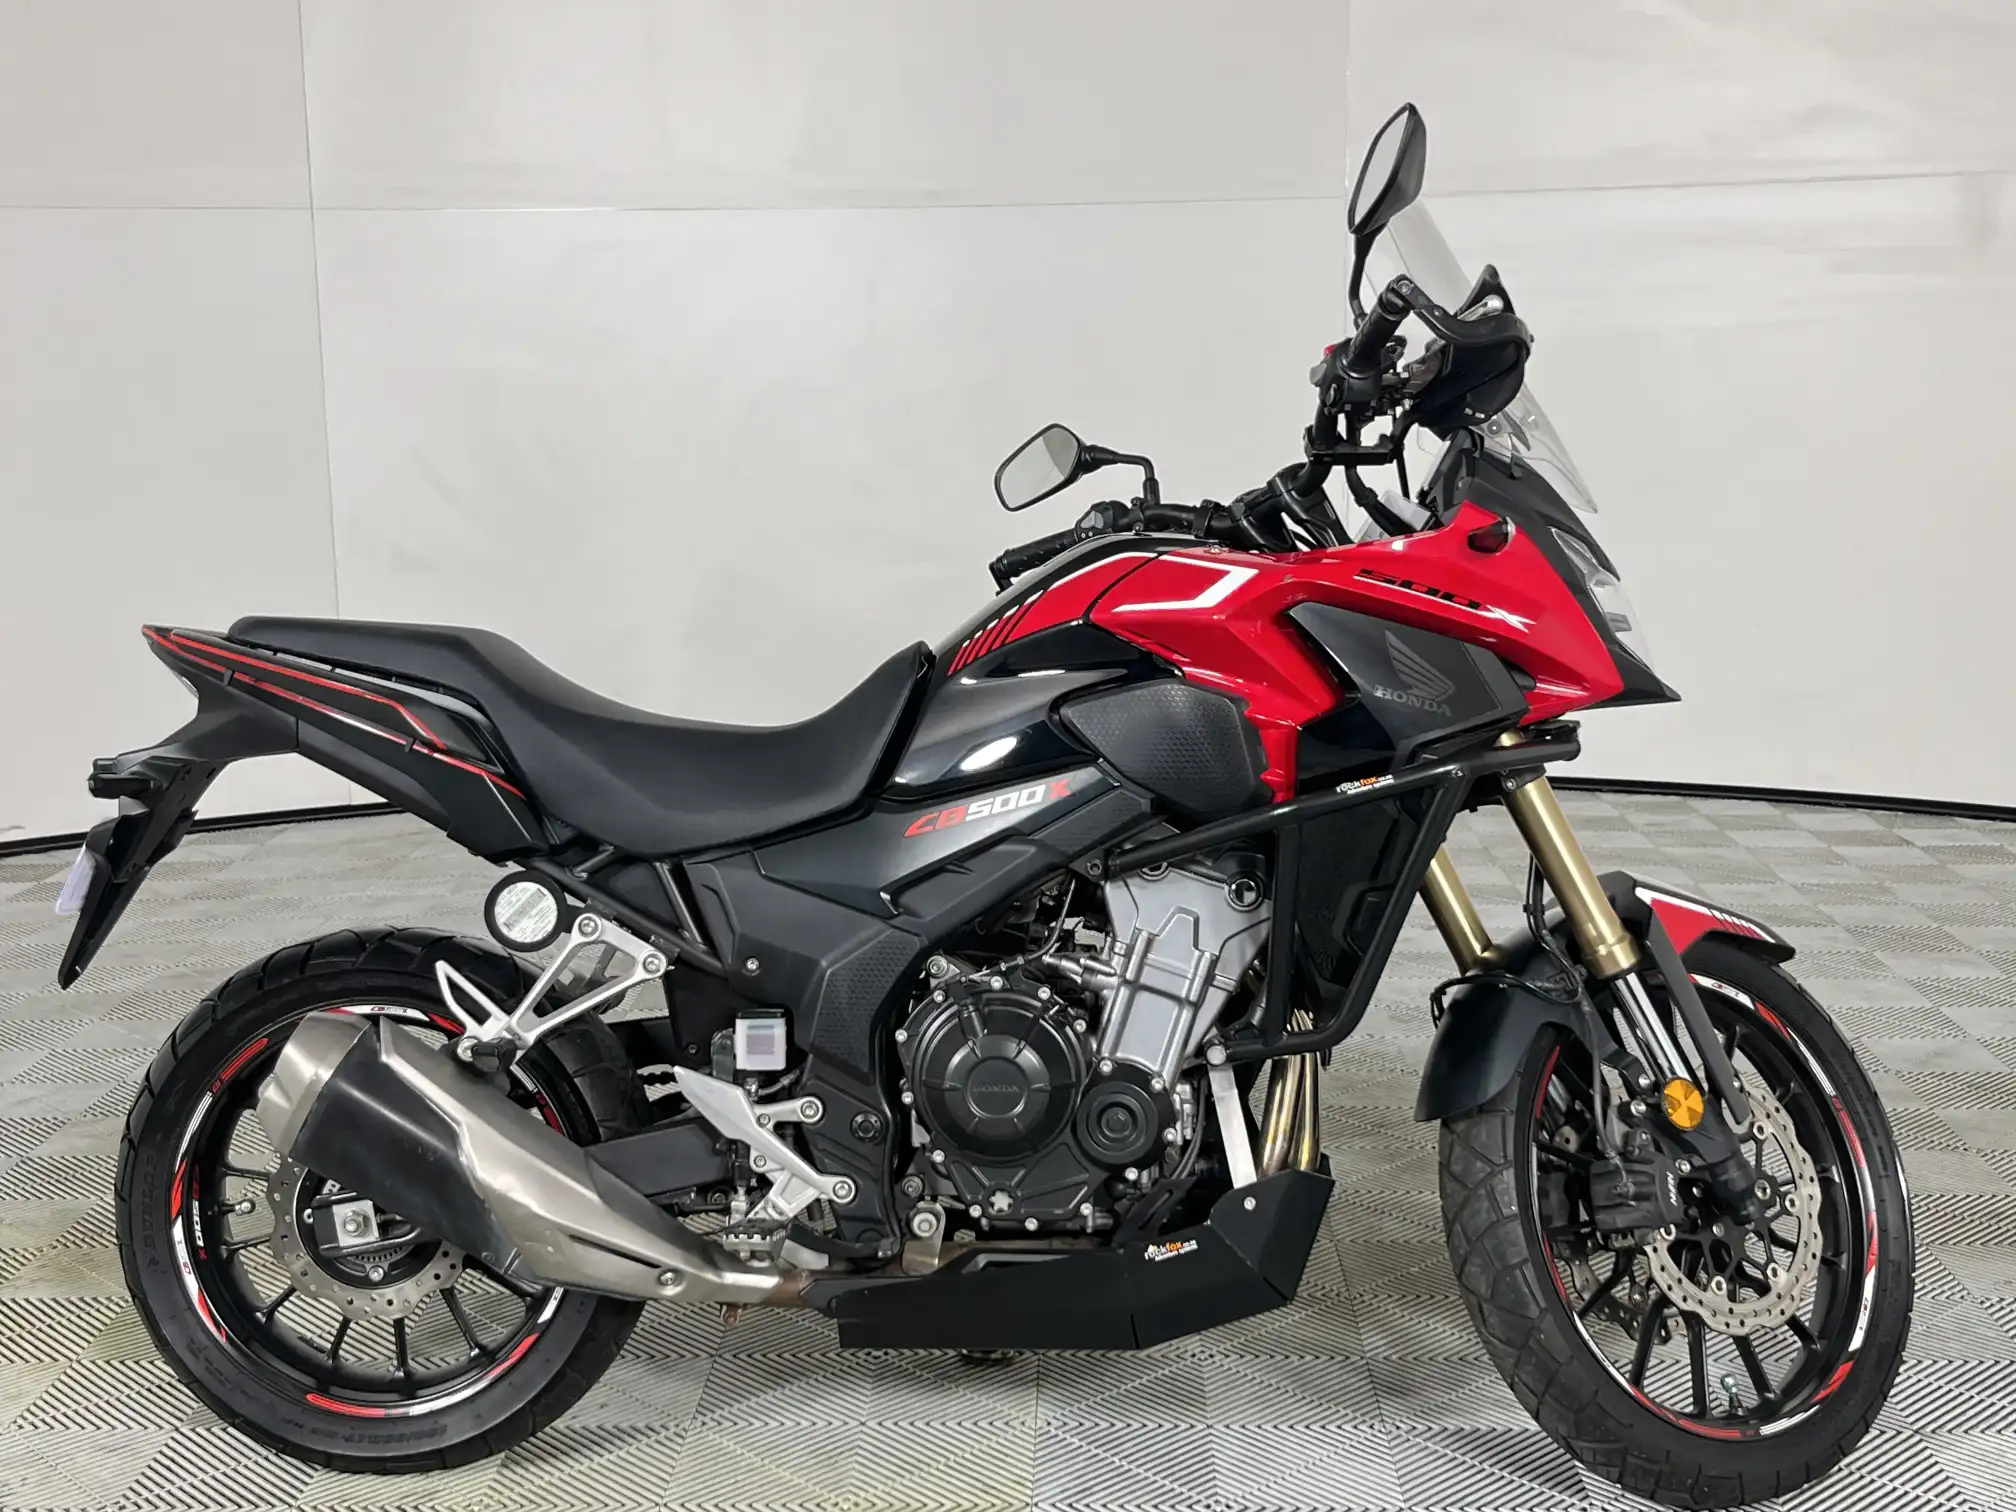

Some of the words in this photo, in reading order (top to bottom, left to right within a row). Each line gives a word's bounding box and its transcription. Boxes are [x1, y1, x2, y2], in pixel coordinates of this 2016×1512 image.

[1353, 568, 1537, 633] 500X
[1373, 684, 1453, 718] HONDA
[904, 778, 1073, 838] CB500X
[972, 1083, 1021, 1093] HONDA
